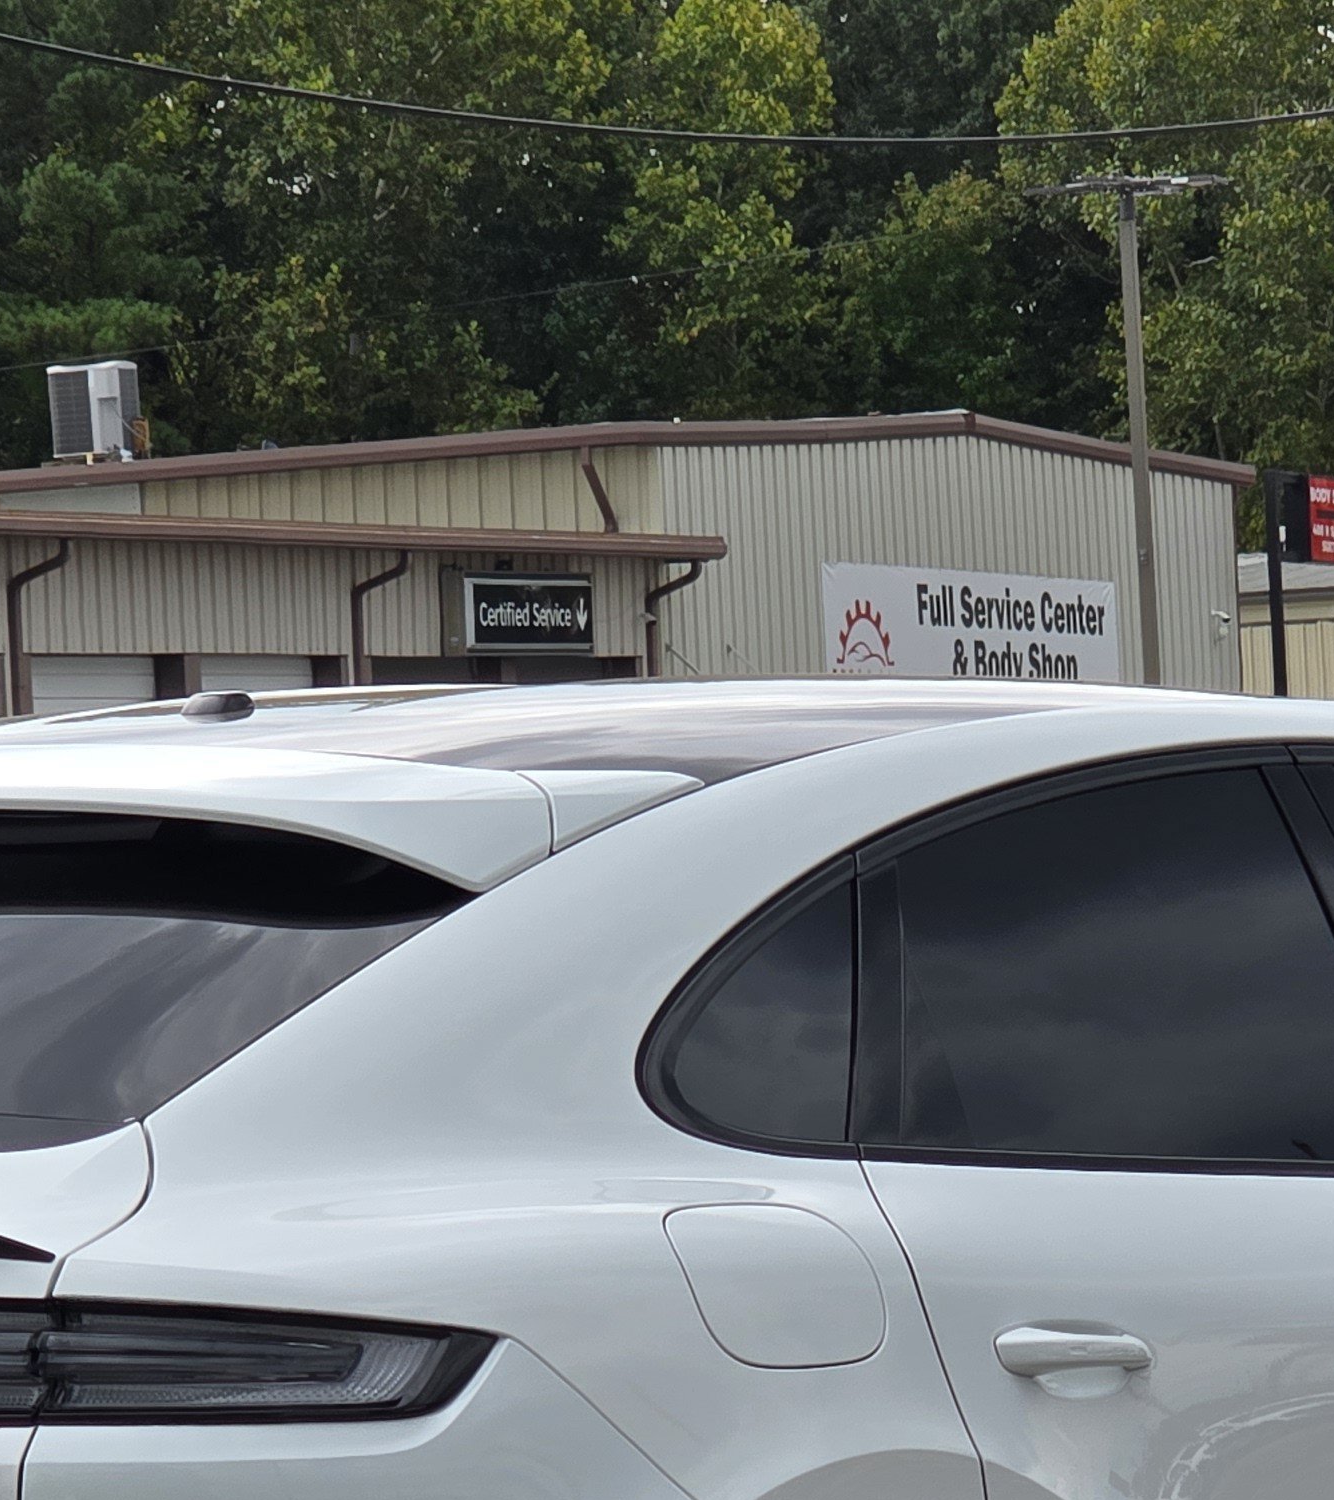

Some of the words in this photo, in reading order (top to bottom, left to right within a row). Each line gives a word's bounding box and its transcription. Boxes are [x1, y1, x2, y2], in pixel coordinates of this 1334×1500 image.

[479, 602, 530, 627] Certified
[533, 602, 572, 627] Service
[917, 583, 954, 627] Full
[961, 586, 1035, 632] Service
[1041, 591, 1105, 636] Center
[953, 639, 967, 676] &
